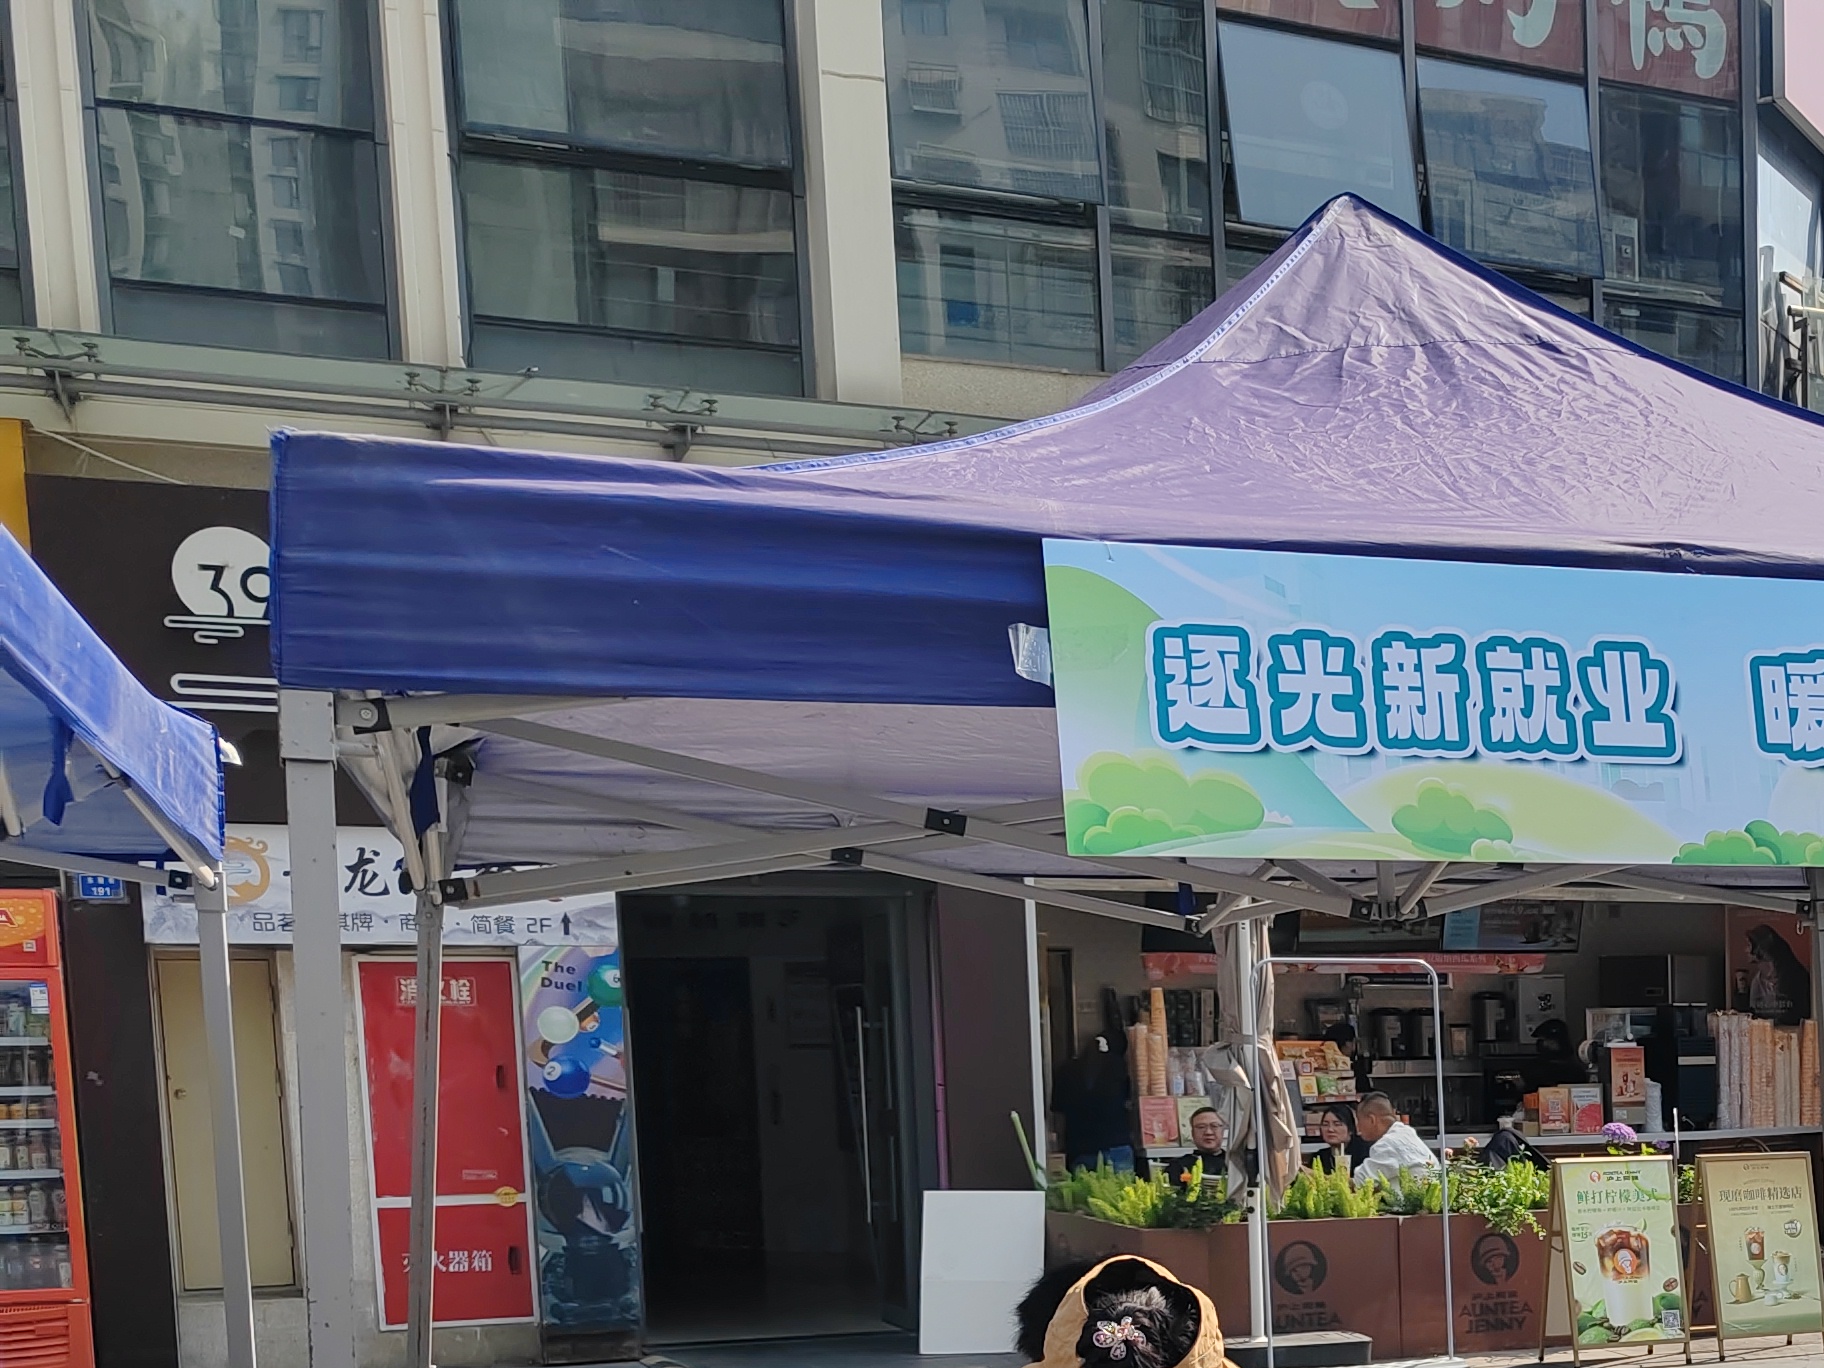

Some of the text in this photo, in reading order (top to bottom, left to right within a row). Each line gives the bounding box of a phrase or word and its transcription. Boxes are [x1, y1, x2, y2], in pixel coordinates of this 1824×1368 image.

[1152, 624, 1682, 763] 逐光新就业
[91, 886, 111, 896] 191
[470, 914, 516, 935] 简餐
[526, 918, 552, 934] 2F
[541, 961, 577, 975] The
[540, 977, 584, 993] Duel
[1459, 1301, 1534, 1318] AUNTEA
[1271, 1311, 1343, 1330] UNTEA
[1465, 1315, 1527, 1334] JENNY
